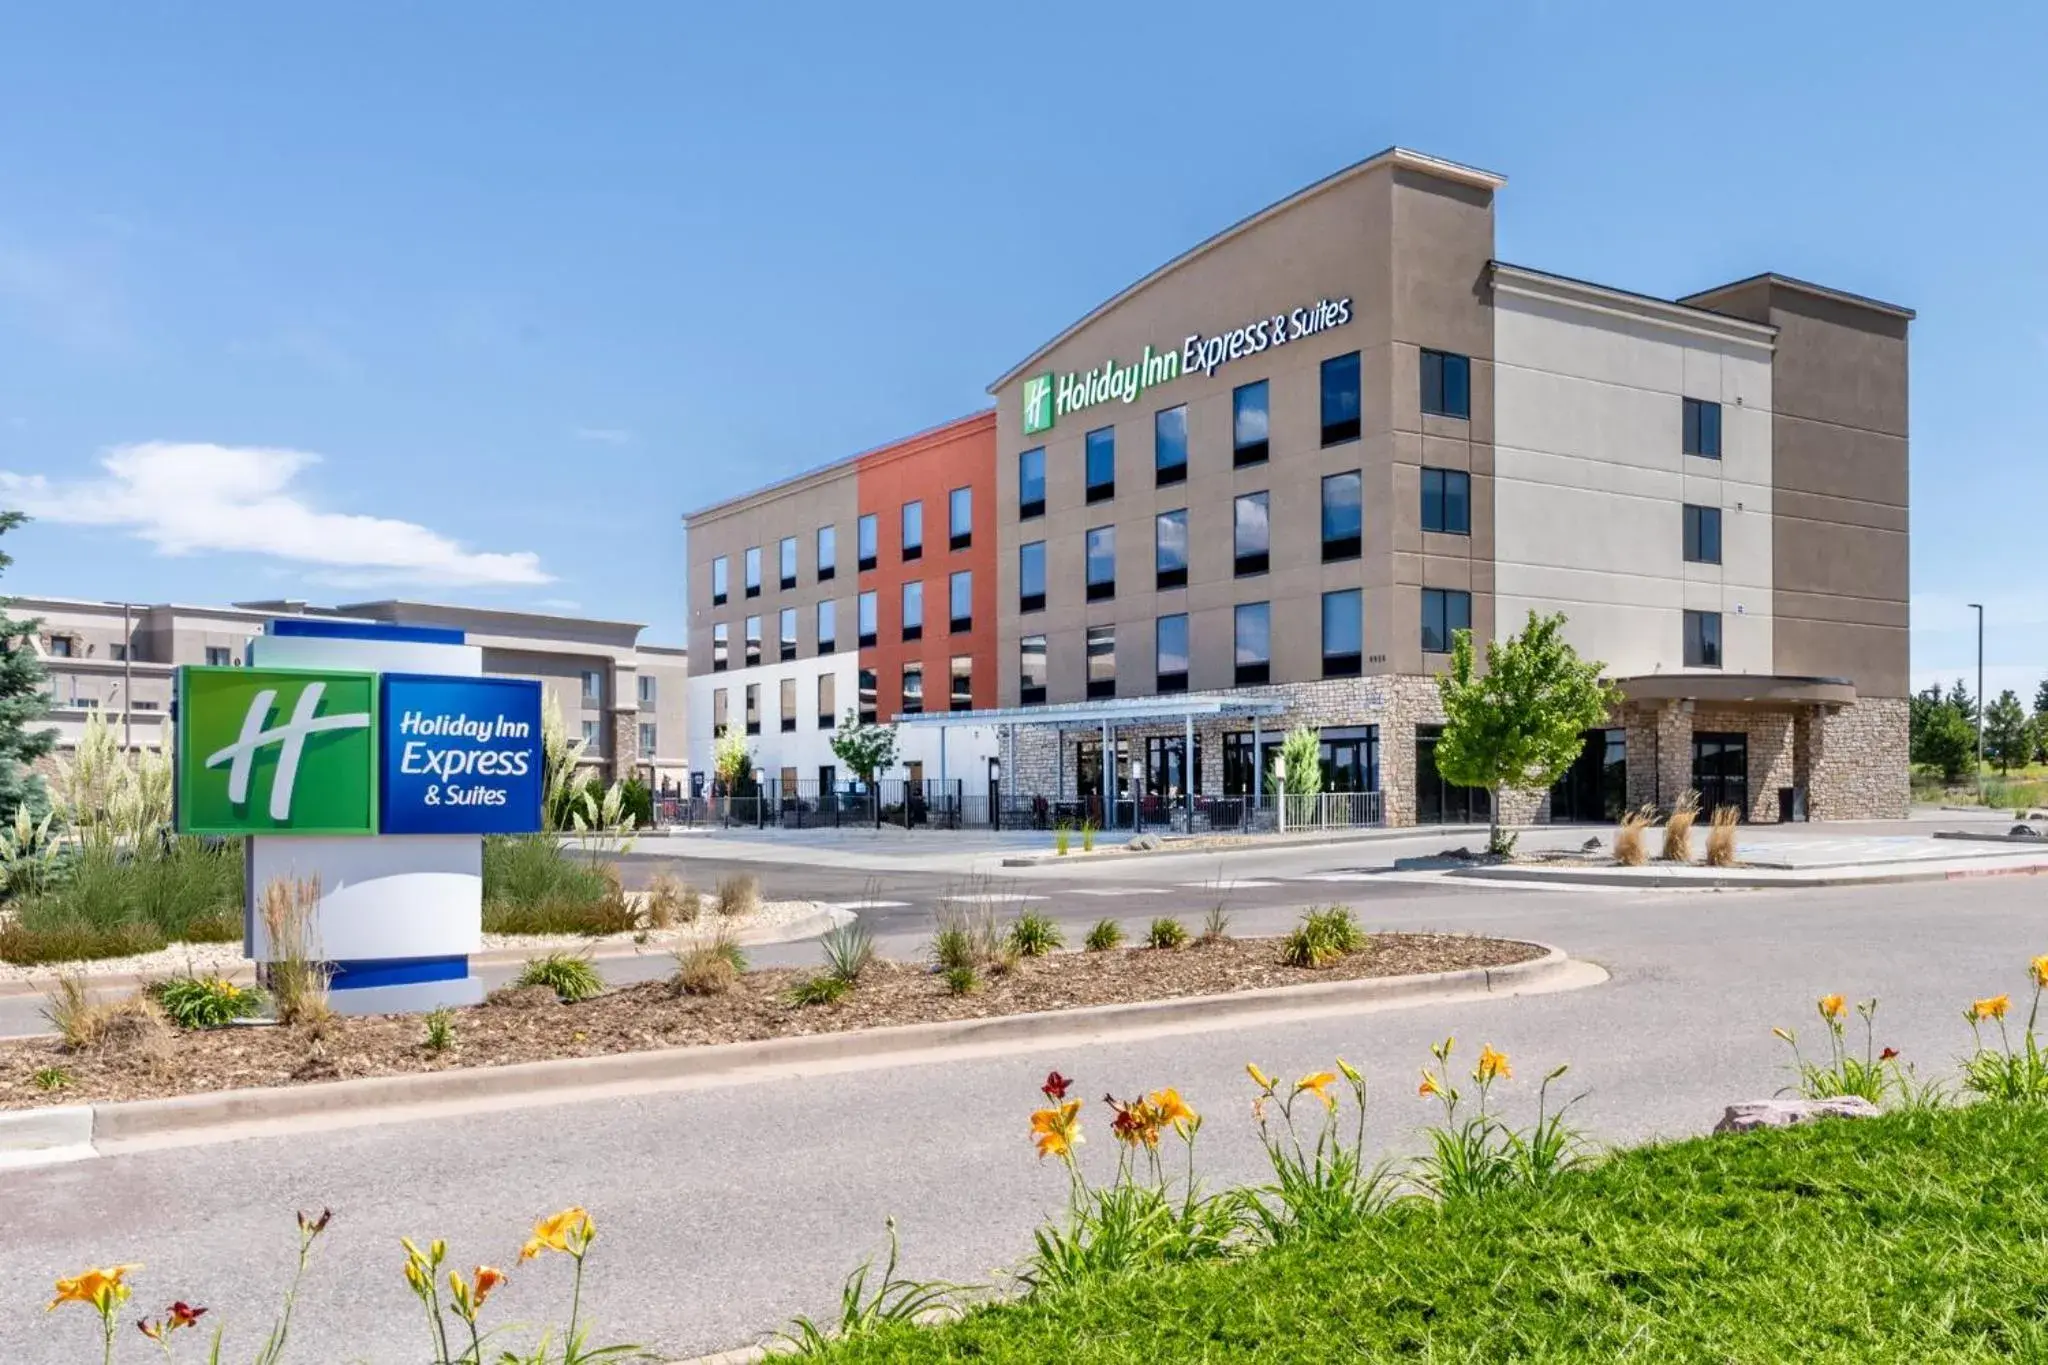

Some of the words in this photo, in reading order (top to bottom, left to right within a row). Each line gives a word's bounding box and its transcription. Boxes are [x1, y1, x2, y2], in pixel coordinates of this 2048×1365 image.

[1057, 360, 1140, 416] Holiday
[1142, 346, 1178, 387] Inn
[1182, 320, 1269, 377] Express
[1272, 314, 1287, 344] &
[1290, 299, 1350, 341] Suites
[400, 711, 491, 742] Holiday
[494, 714, 529, 738] Inn
[205, 682, 370, 821] H
[401, 742, 530, 783] Express
[424, 785, 440, 805] &
[445, 785, 506, 806] Suites
